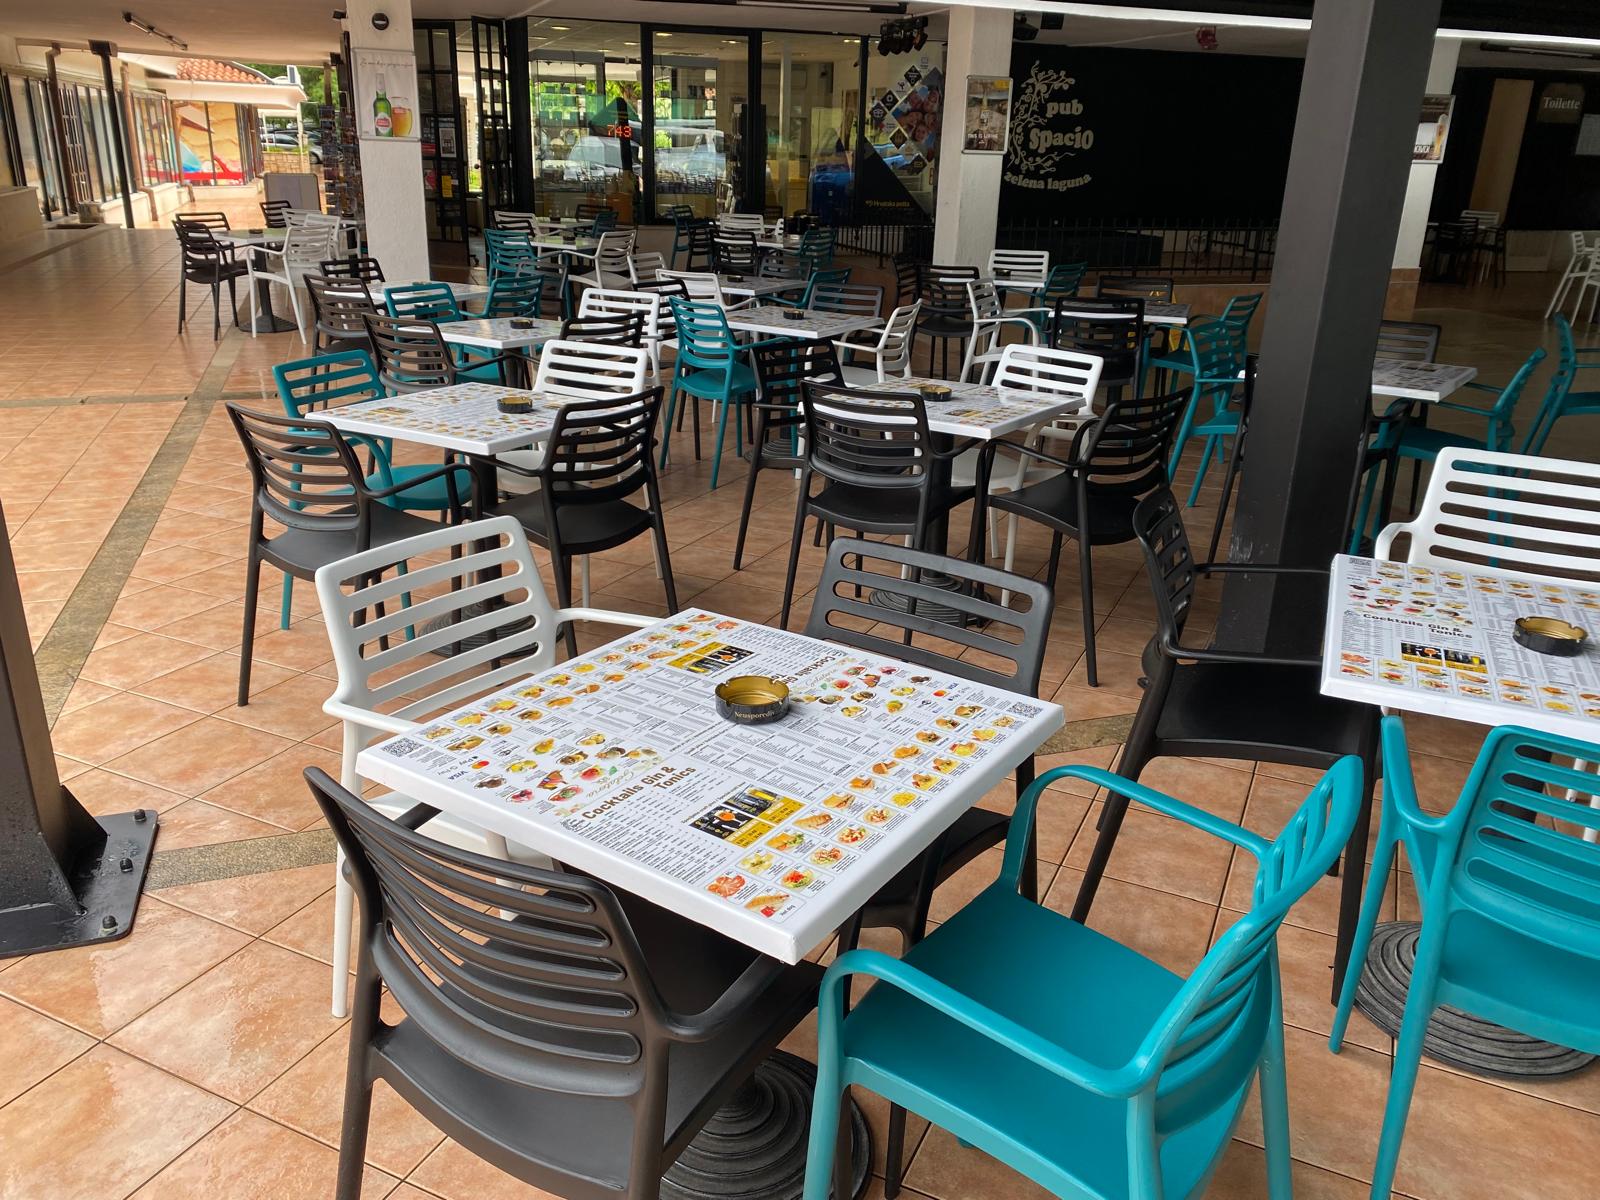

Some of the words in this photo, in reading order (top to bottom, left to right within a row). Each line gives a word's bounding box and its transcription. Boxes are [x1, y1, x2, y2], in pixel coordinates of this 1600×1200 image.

[1046, 99, 1083, 118] pub
[1543, 96, 1581, 110] Toilette
[1029, 126, 1094, 153] Spacio
[1048, 174, 1092, 192] laguna
[1363, 613, 1424, 627] Cocktails
[1428, 623, 1449, 631] Gin
[1431, 628, 1473, 639] Tonics
[653, 767, 697, 790] Tonics
[582, 783, 644, 820] Cocktails
[640, 771, 666, 785] Gin
